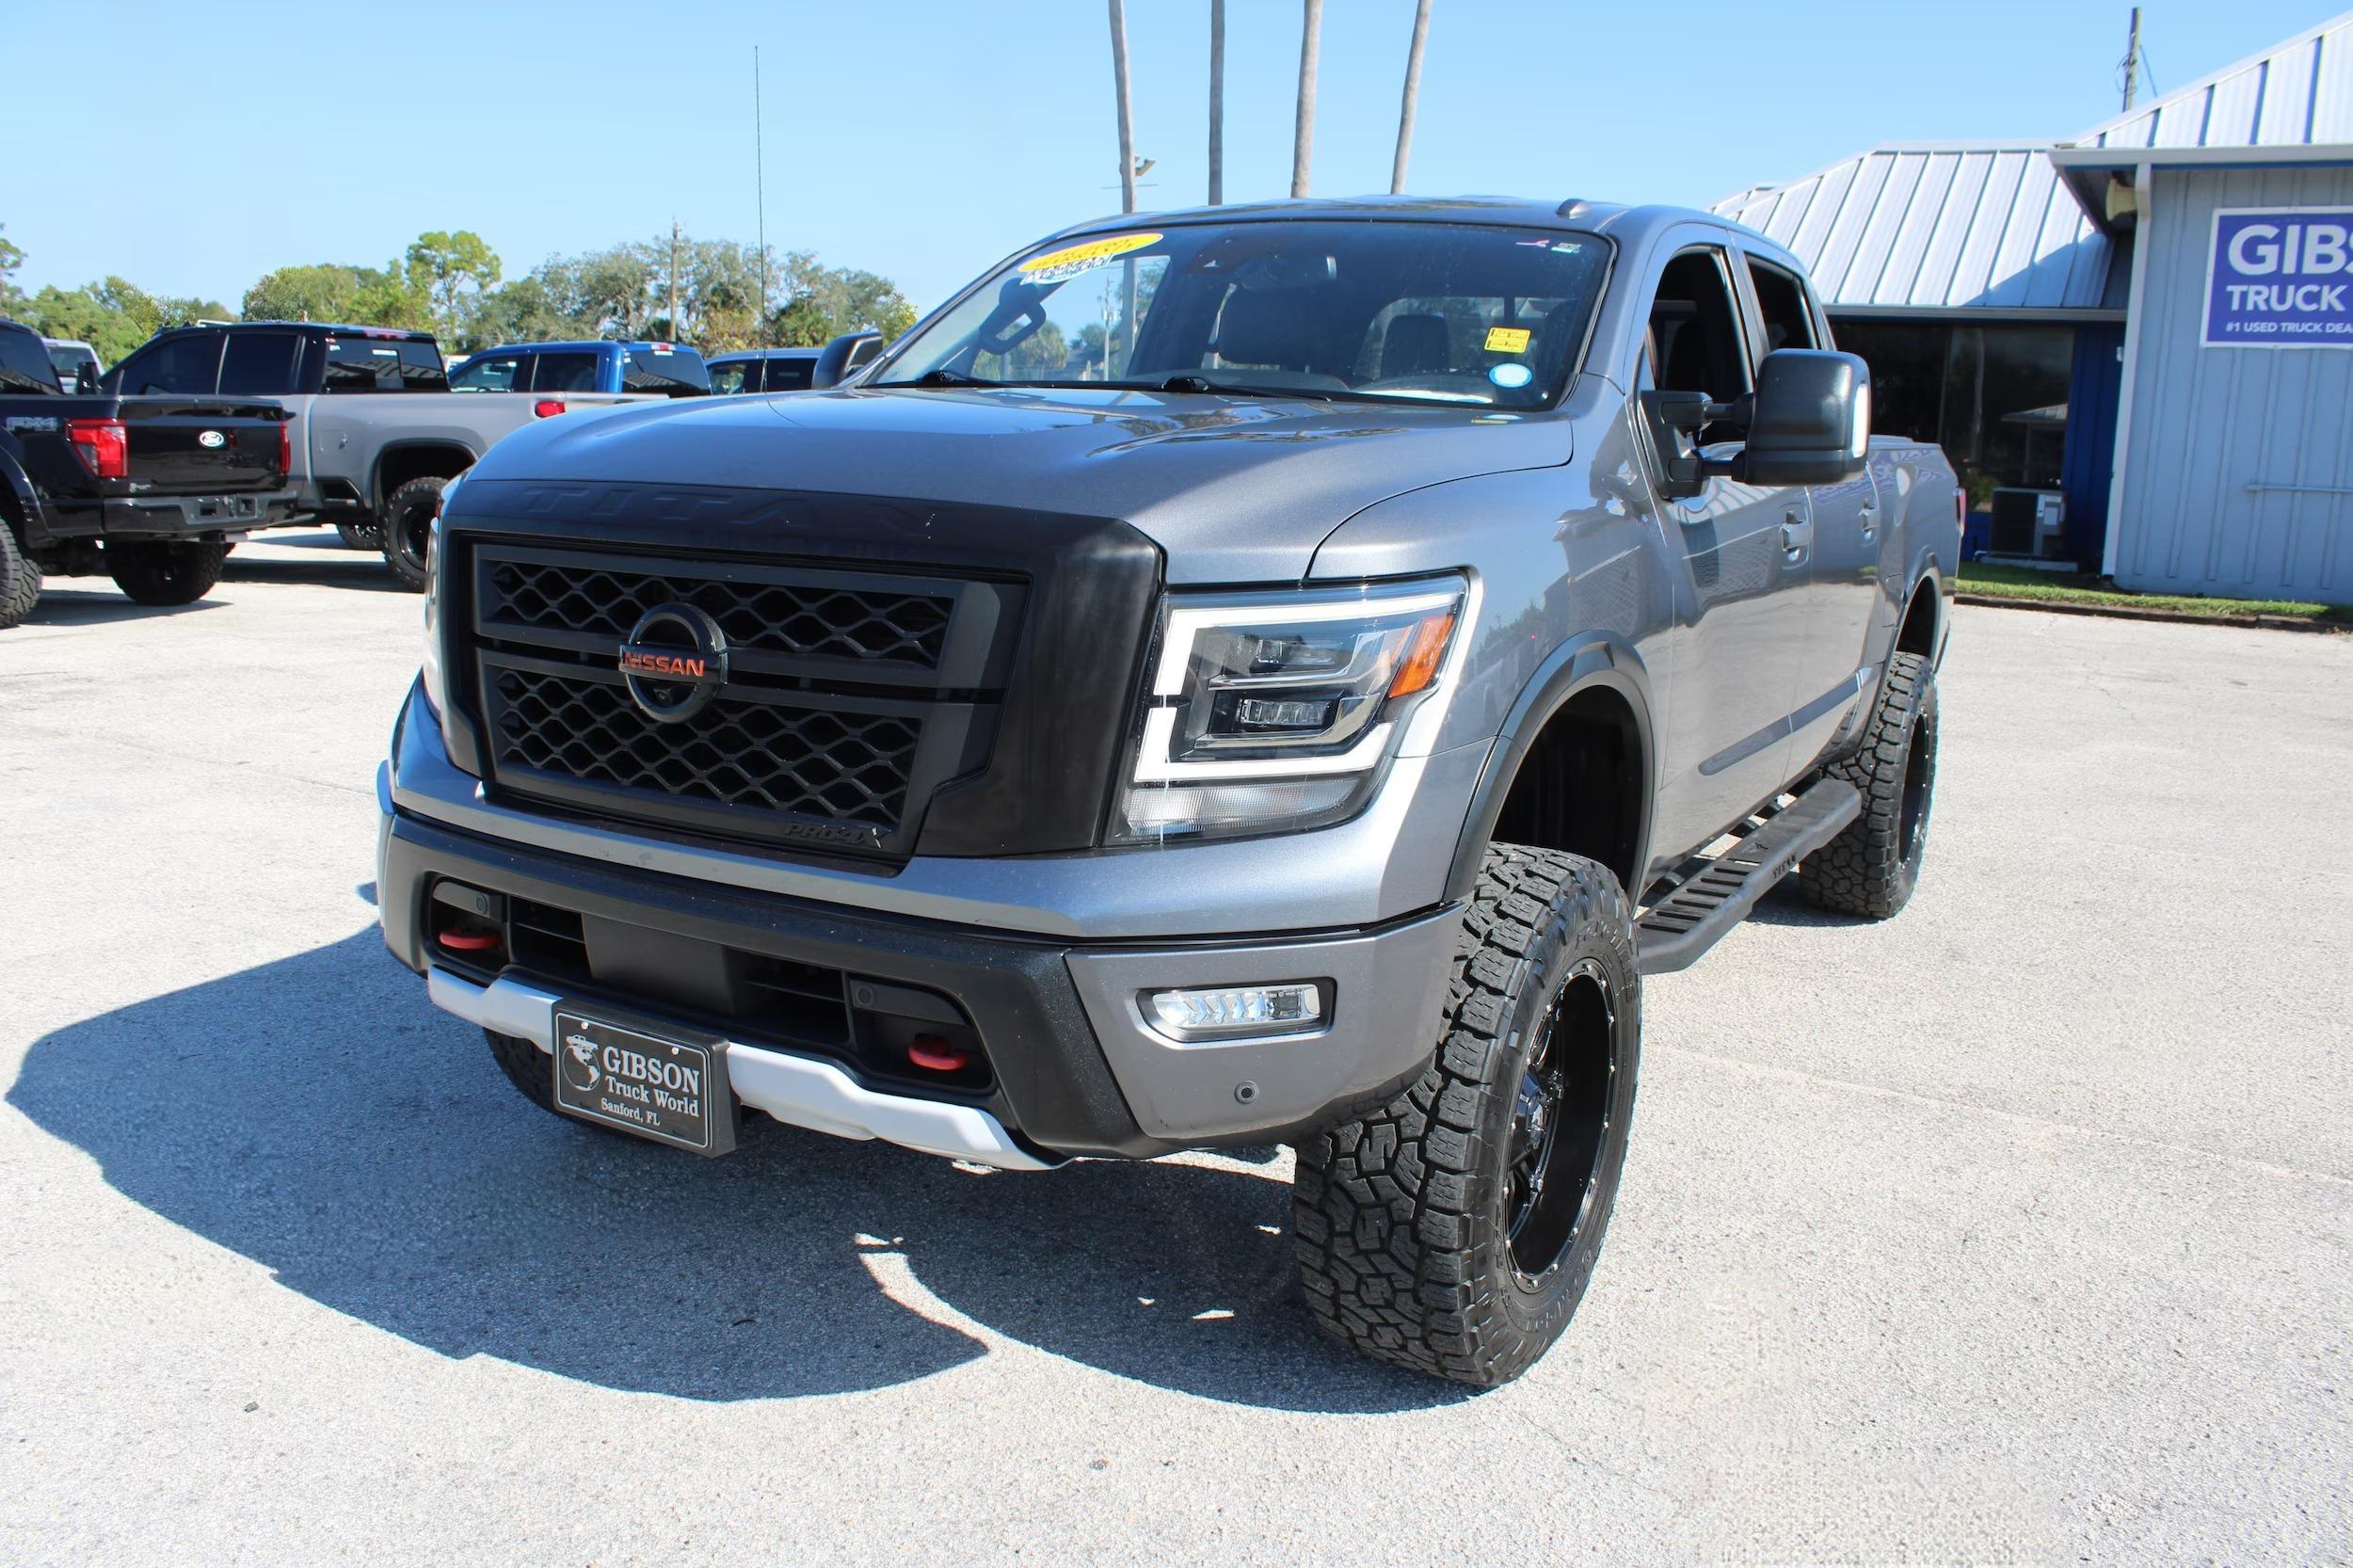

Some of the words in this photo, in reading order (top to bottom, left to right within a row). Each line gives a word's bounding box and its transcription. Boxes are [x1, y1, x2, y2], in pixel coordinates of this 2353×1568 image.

[2228, 224, 2353, 276] GIB
[2226, 284, 2348, 312] TRUCK
[2225, 322, 2240, 332] #1
[2244, 322, 2278, 332] USED
[2280, 322, 2323, 333] TRUCK
[624, 650, 705, 678] NISSAN
[603, 1046, 700, 1096] GIBSON
[605, 1075, 650, 1104] Truck
[653, 1088, 699, 1118] World
[600, 1097, 644, 1124] Sanford,
[646, 1110, 661, 1126] FL
